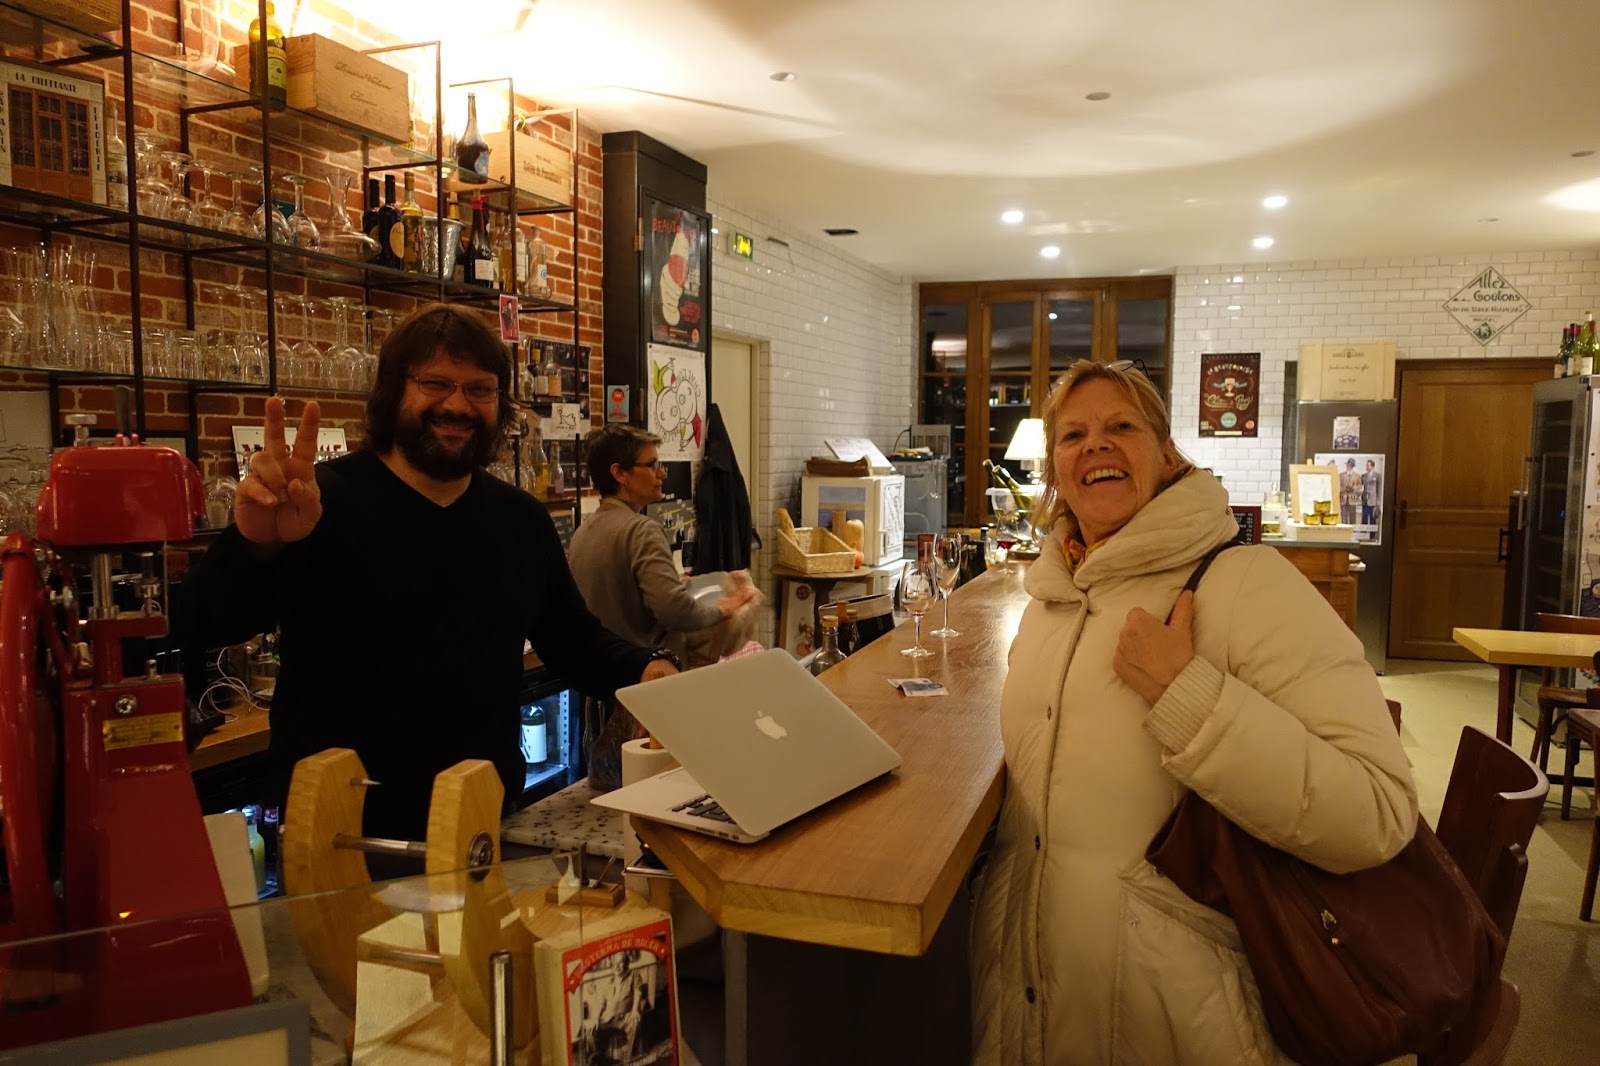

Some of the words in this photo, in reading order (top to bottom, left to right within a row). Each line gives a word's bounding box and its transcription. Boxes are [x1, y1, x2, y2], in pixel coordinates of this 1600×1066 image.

[15, 72, 26, 82] LA
[32, 76, 77, 92] DILETTANTE
[1468, 269, 1511, 289] Allez
